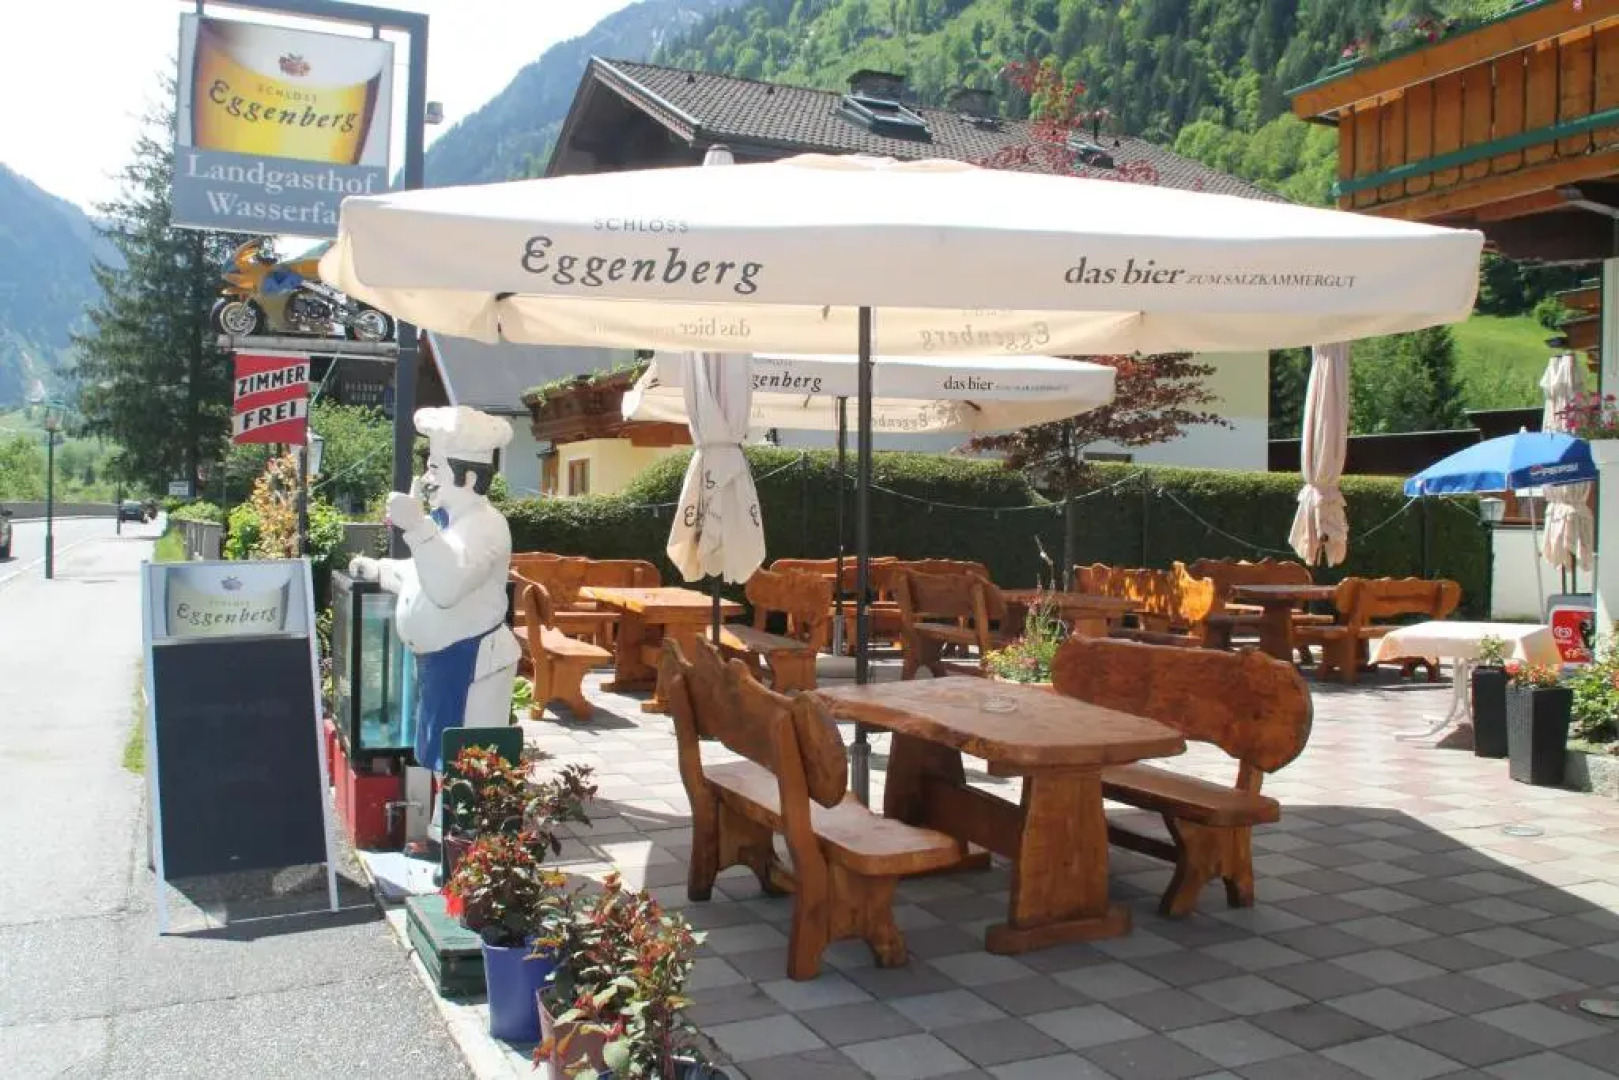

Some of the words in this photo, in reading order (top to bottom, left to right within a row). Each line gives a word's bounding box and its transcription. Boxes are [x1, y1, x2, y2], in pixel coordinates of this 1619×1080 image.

[208, 79, 359, 133] Eggenberg
[186, 154, 379, 195] Landgasthof
[206, 190, 340, 225] Wasserfa
[593, 217, 689, 233] SCHLOSS
[521, 236, 763, 295] Eggenberg
[1064, 256, 1117, 285] das
[1122, 258, 1186, 285] bier
[238, 365, 306, 397] ZIMMER
[752, 370, 823, 393] genberg
[943, 375, 965, 391] das
[967, 375, 994, 391] bier
[243, 401, 297, 431] FREI
[176, 602, 278, 627] Eggenberg
